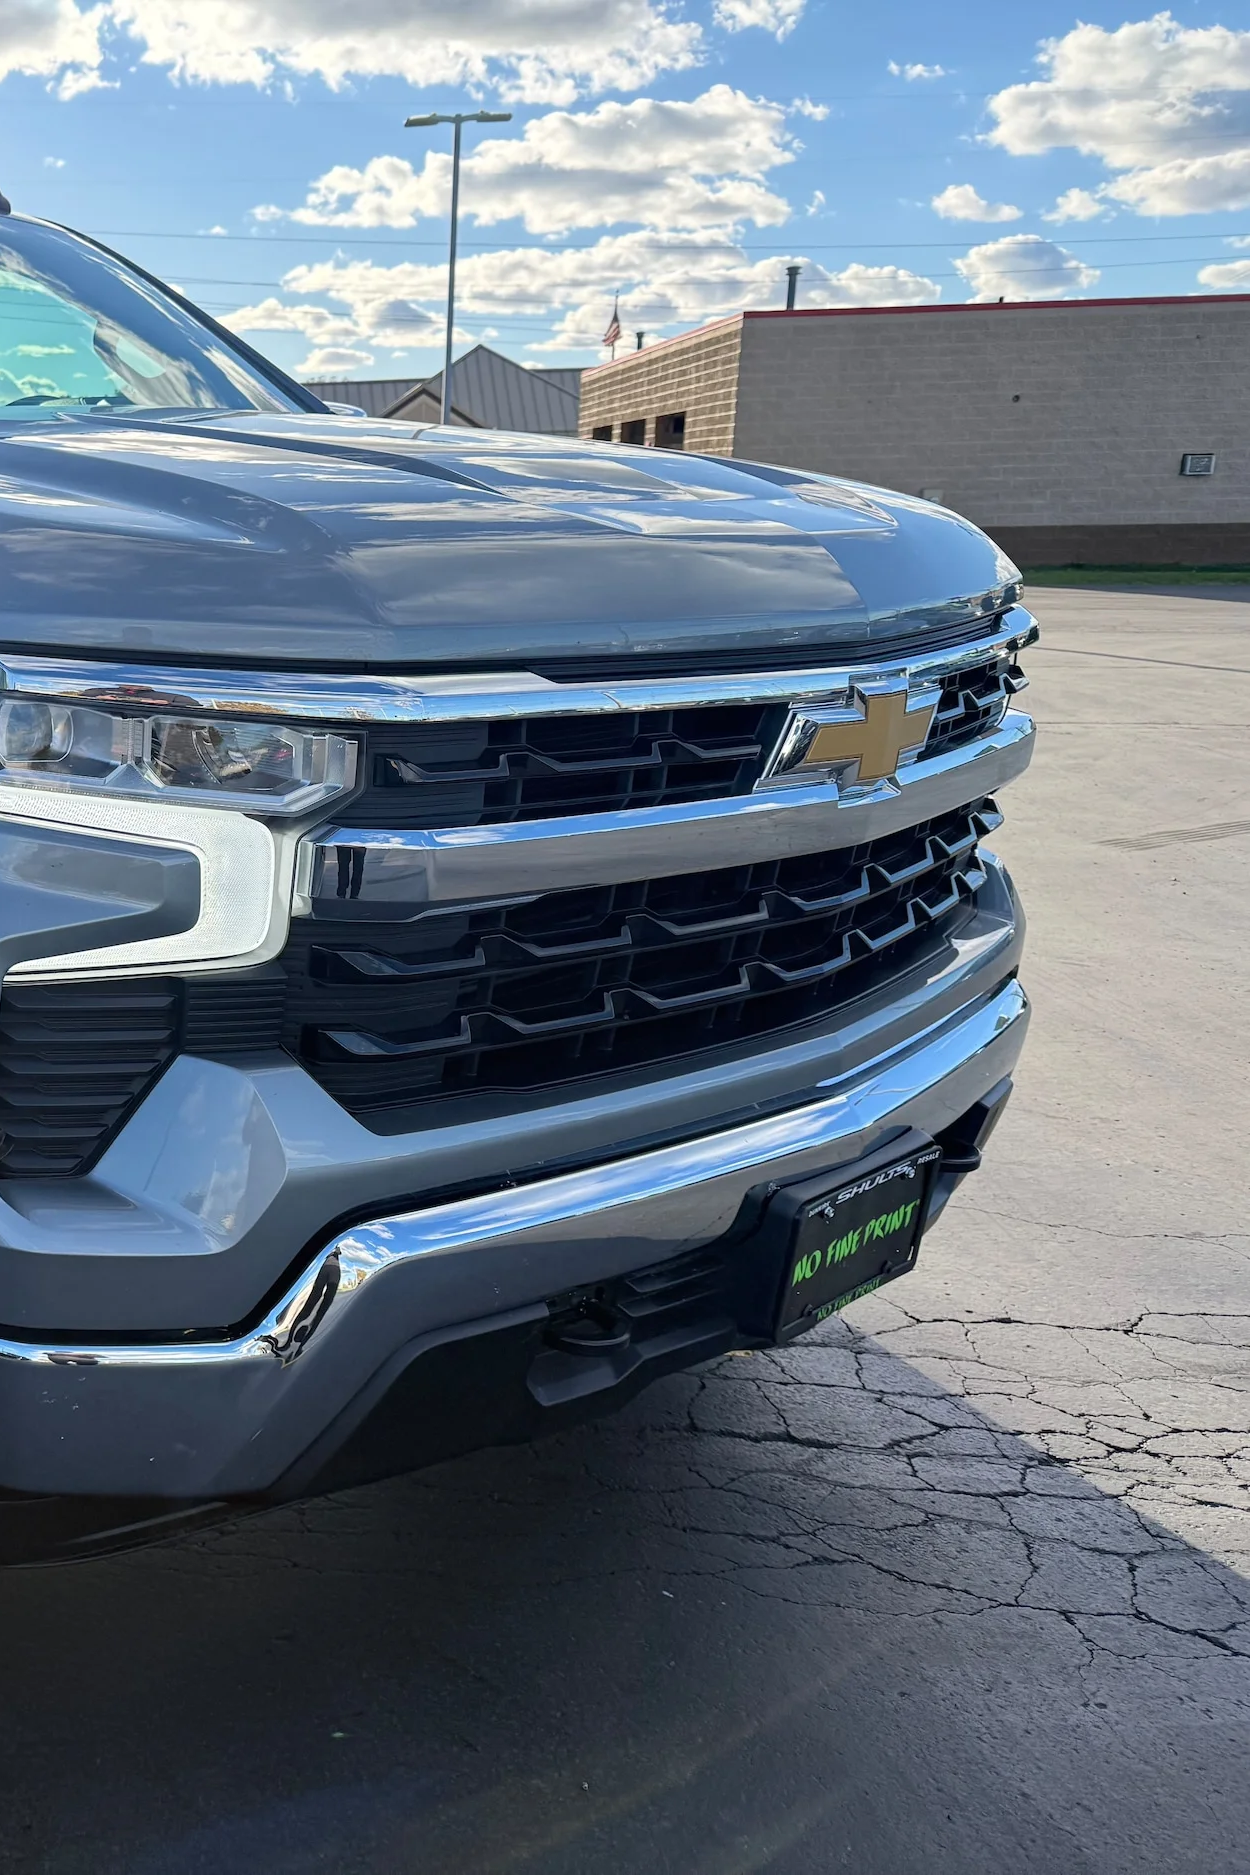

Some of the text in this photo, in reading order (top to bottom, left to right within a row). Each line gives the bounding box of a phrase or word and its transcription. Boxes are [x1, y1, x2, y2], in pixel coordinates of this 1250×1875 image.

[917, 1151, 940, 1164] RESALE
[836, 1161, 912, 1204] SHULTS
[792, 1200, 917, 1287] NO FINE PRINT
[816, 1305, 832, 1320] NO
[855, 1278, 880, 1298] PRINT
